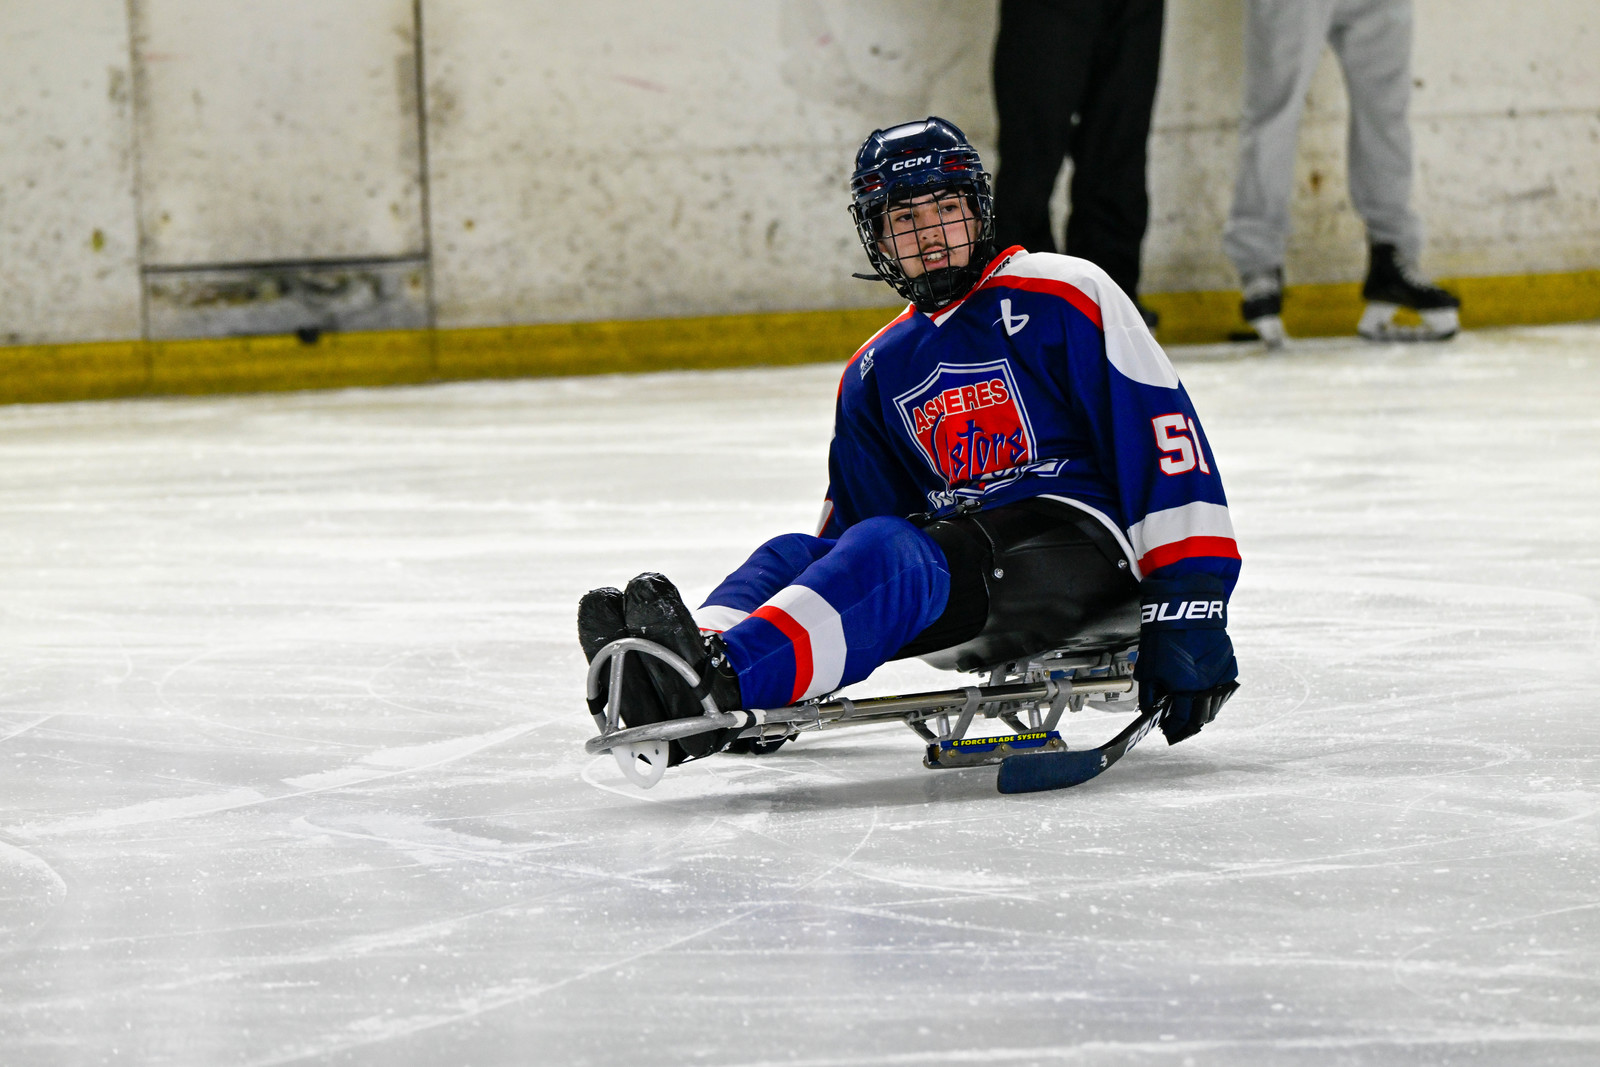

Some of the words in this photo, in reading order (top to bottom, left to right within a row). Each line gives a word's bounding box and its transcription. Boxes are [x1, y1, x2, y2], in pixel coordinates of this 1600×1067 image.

[892, 155, 932, 172] CCM
[1151, 413, 1211, 476] 51
[1141, 600, 1223, 624] AUER
[961, 738, 986, 746] FORCE
[988, 735, 1015, 744] BLADE
[1017, 732, 1047, 741] SYSTEM
